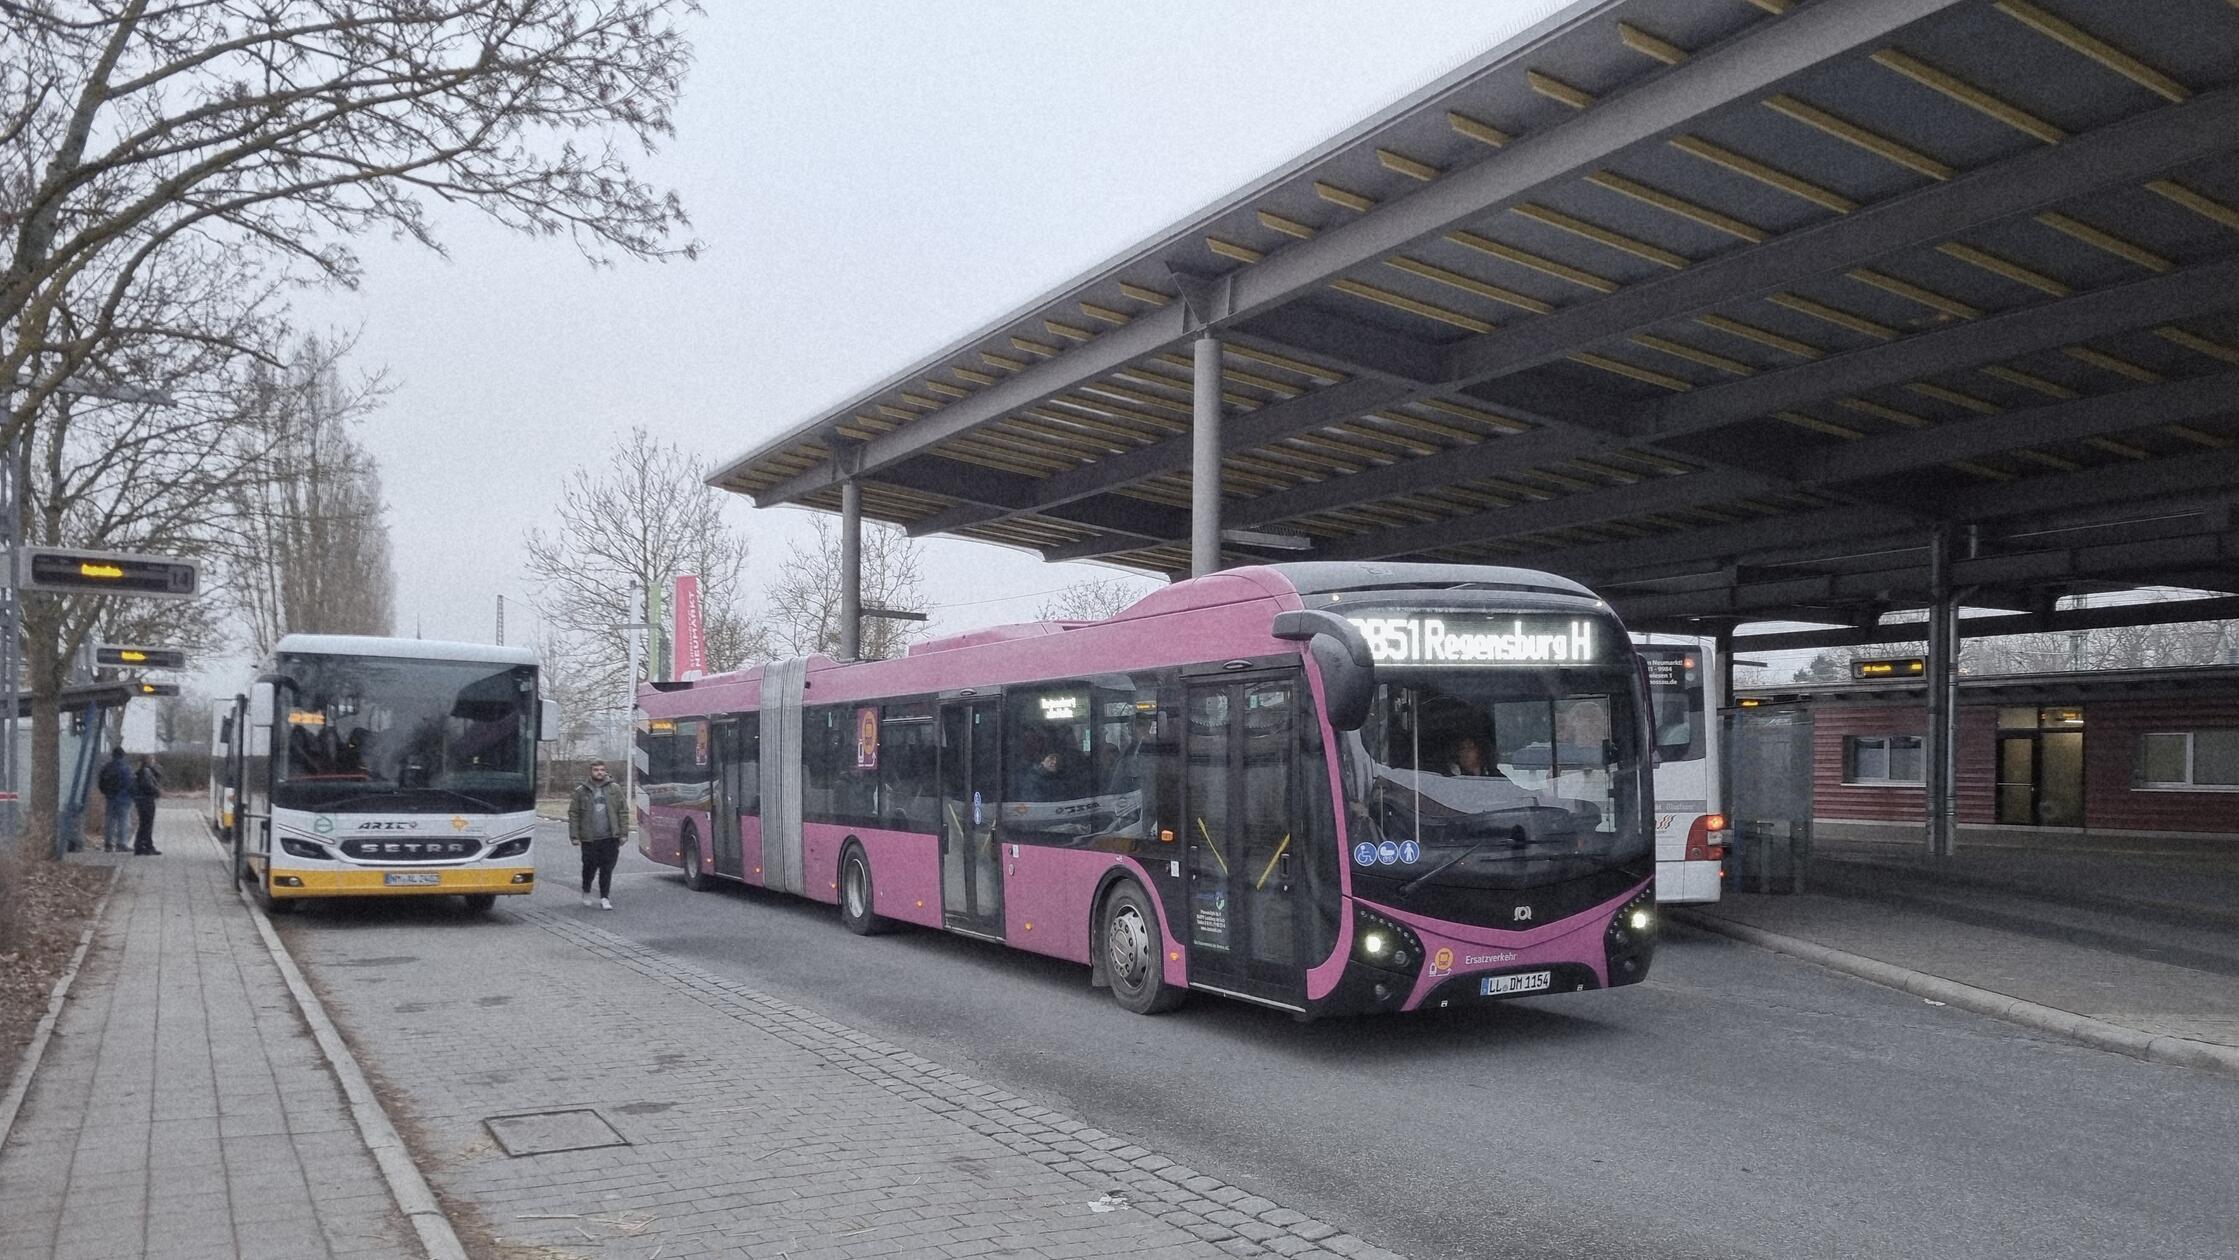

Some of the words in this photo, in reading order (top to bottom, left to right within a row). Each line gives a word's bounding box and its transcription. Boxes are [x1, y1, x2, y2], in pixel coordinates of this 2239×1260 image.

[688, 591, 702, 667] NEUMARKT
[1425, 619, 1567, 660] Regensburg
[1572, 621, 1591, 660] H
[360, 843, 464, 853] SETRA
[1465, 952, 1518, 964] Ersatzverkehr
[1489, 979, 1502, 993] LL
[1509, 976, 1523, 991] DM
[1524, 973, 1549, 989] 1154
